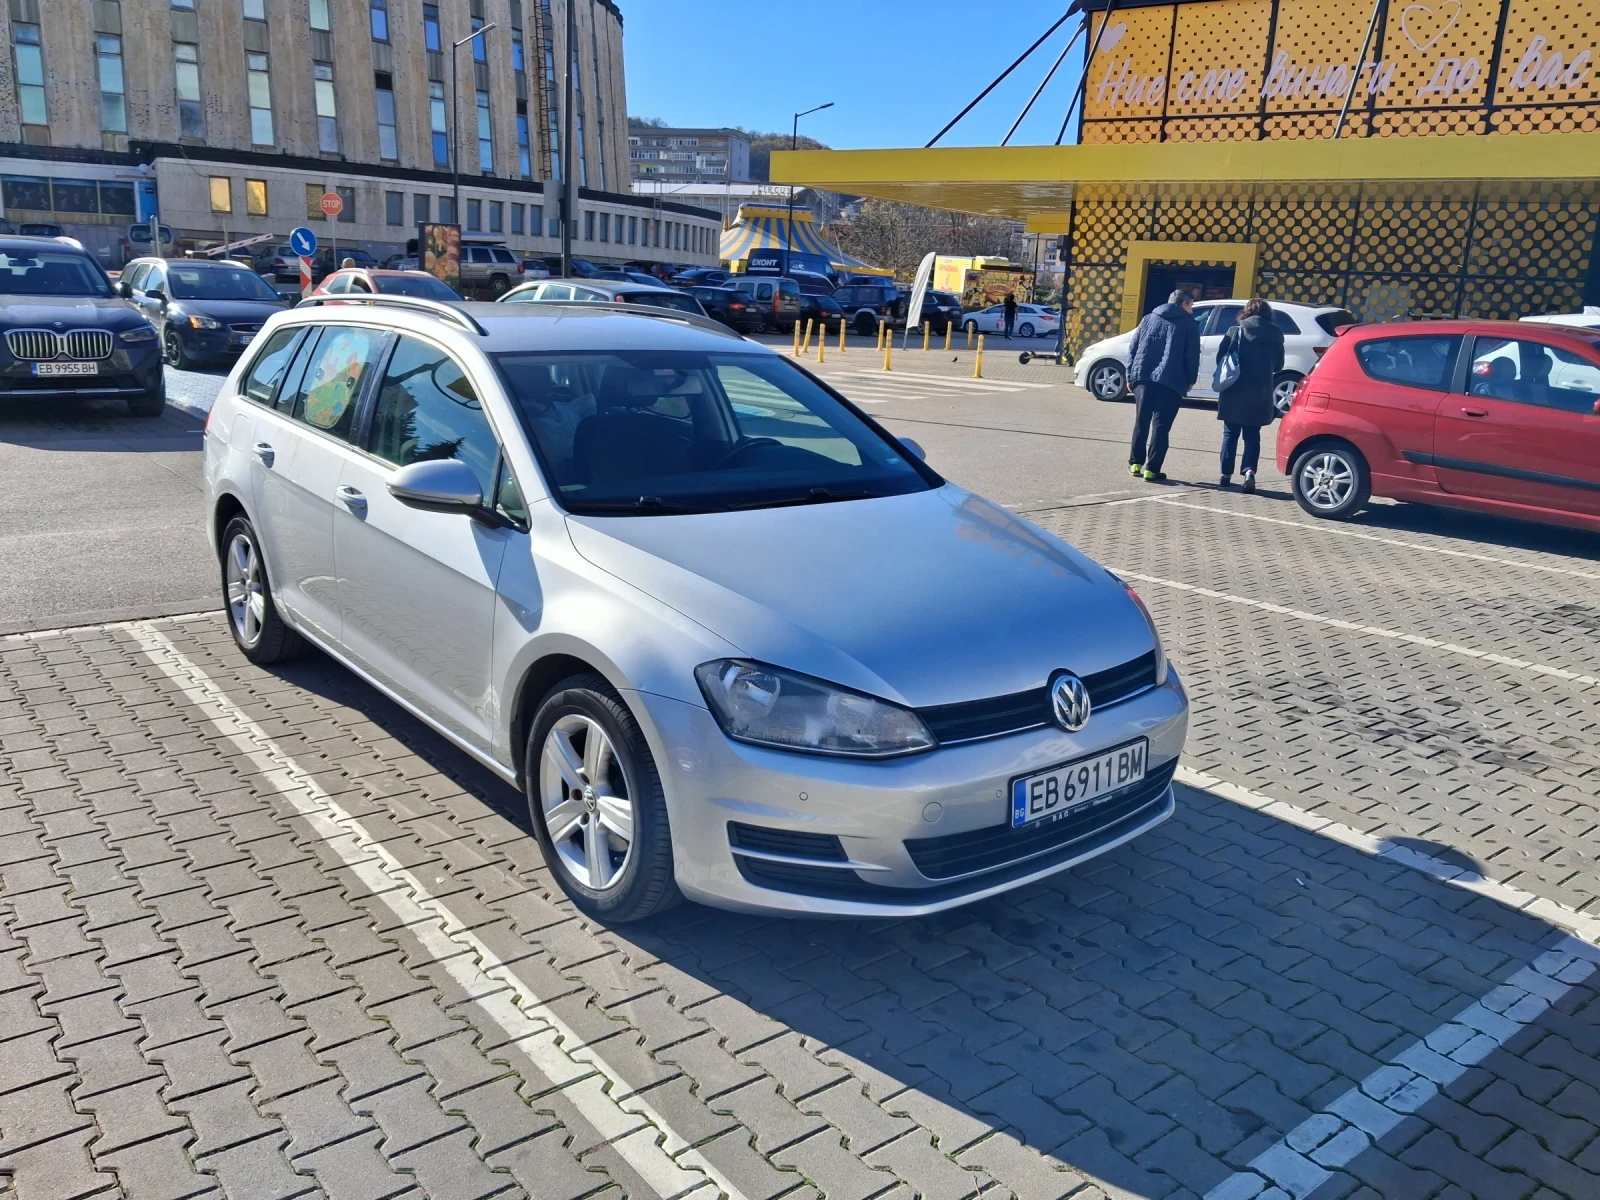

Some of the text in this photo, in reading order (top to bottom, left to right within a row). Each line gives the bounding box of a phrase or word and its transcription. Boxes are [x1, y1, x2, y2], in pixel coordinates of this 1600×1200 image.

[1095, 58, 1167, 109] Ние
[1176, 68, 1249, 103] сме
[1416, 57, 1481, 99] до
[322, 199, 341, 208] STOP
[1015, 807, 1025, 819] BG
